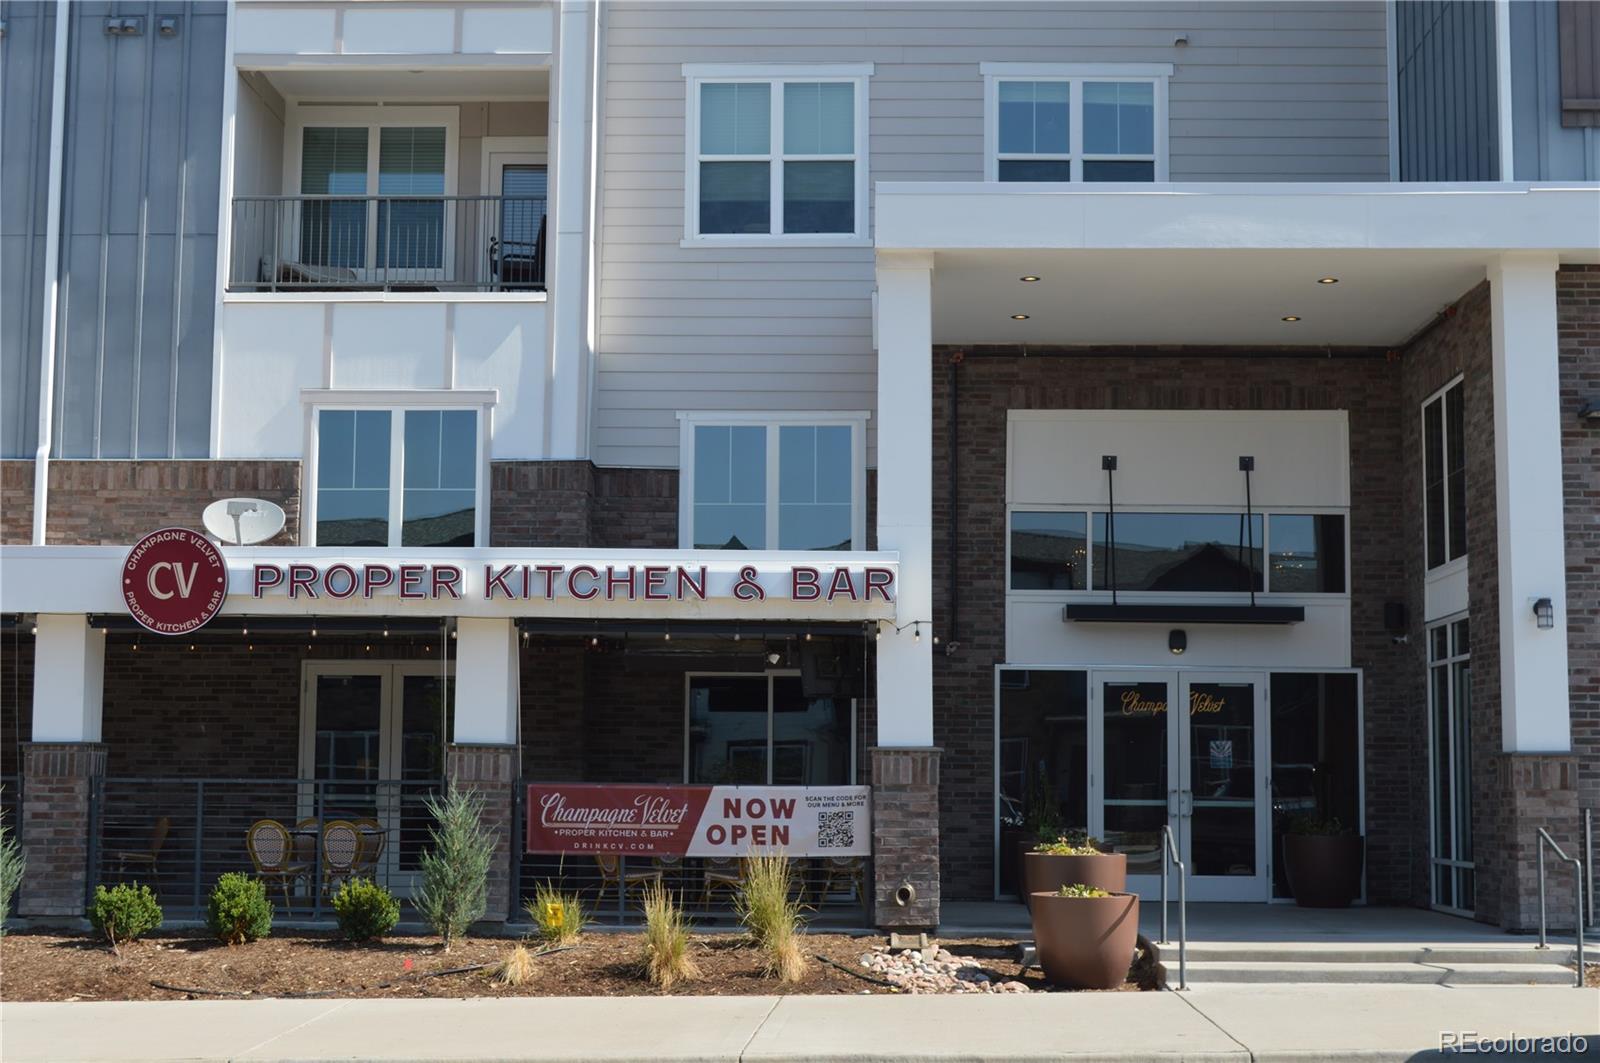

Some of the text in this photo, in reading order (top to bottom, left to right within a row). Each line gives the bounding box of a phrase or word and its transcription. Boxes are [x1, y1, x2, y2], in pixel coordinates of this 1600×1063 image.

[127, 532, 220, 571] CHAMPAGNE VELVET
[147, 561, 199, 600] CV
[252, 563, 895, 602] PROPER KITCHEN & BAR
[126, 590, 221, 632] PROPER KITCHEN & BAR
[1190, 690, 1226, 716] Velvet
[540, 792, 689, 829] Champagne Velvet
[723, 797, 798, 819] NOW
[559, 829, 669, 838] PROPER KITCHEN & BAR
[574, 842, 655, 850] DRINKCV.COM
[706, 824, 790, 846] OPEN
